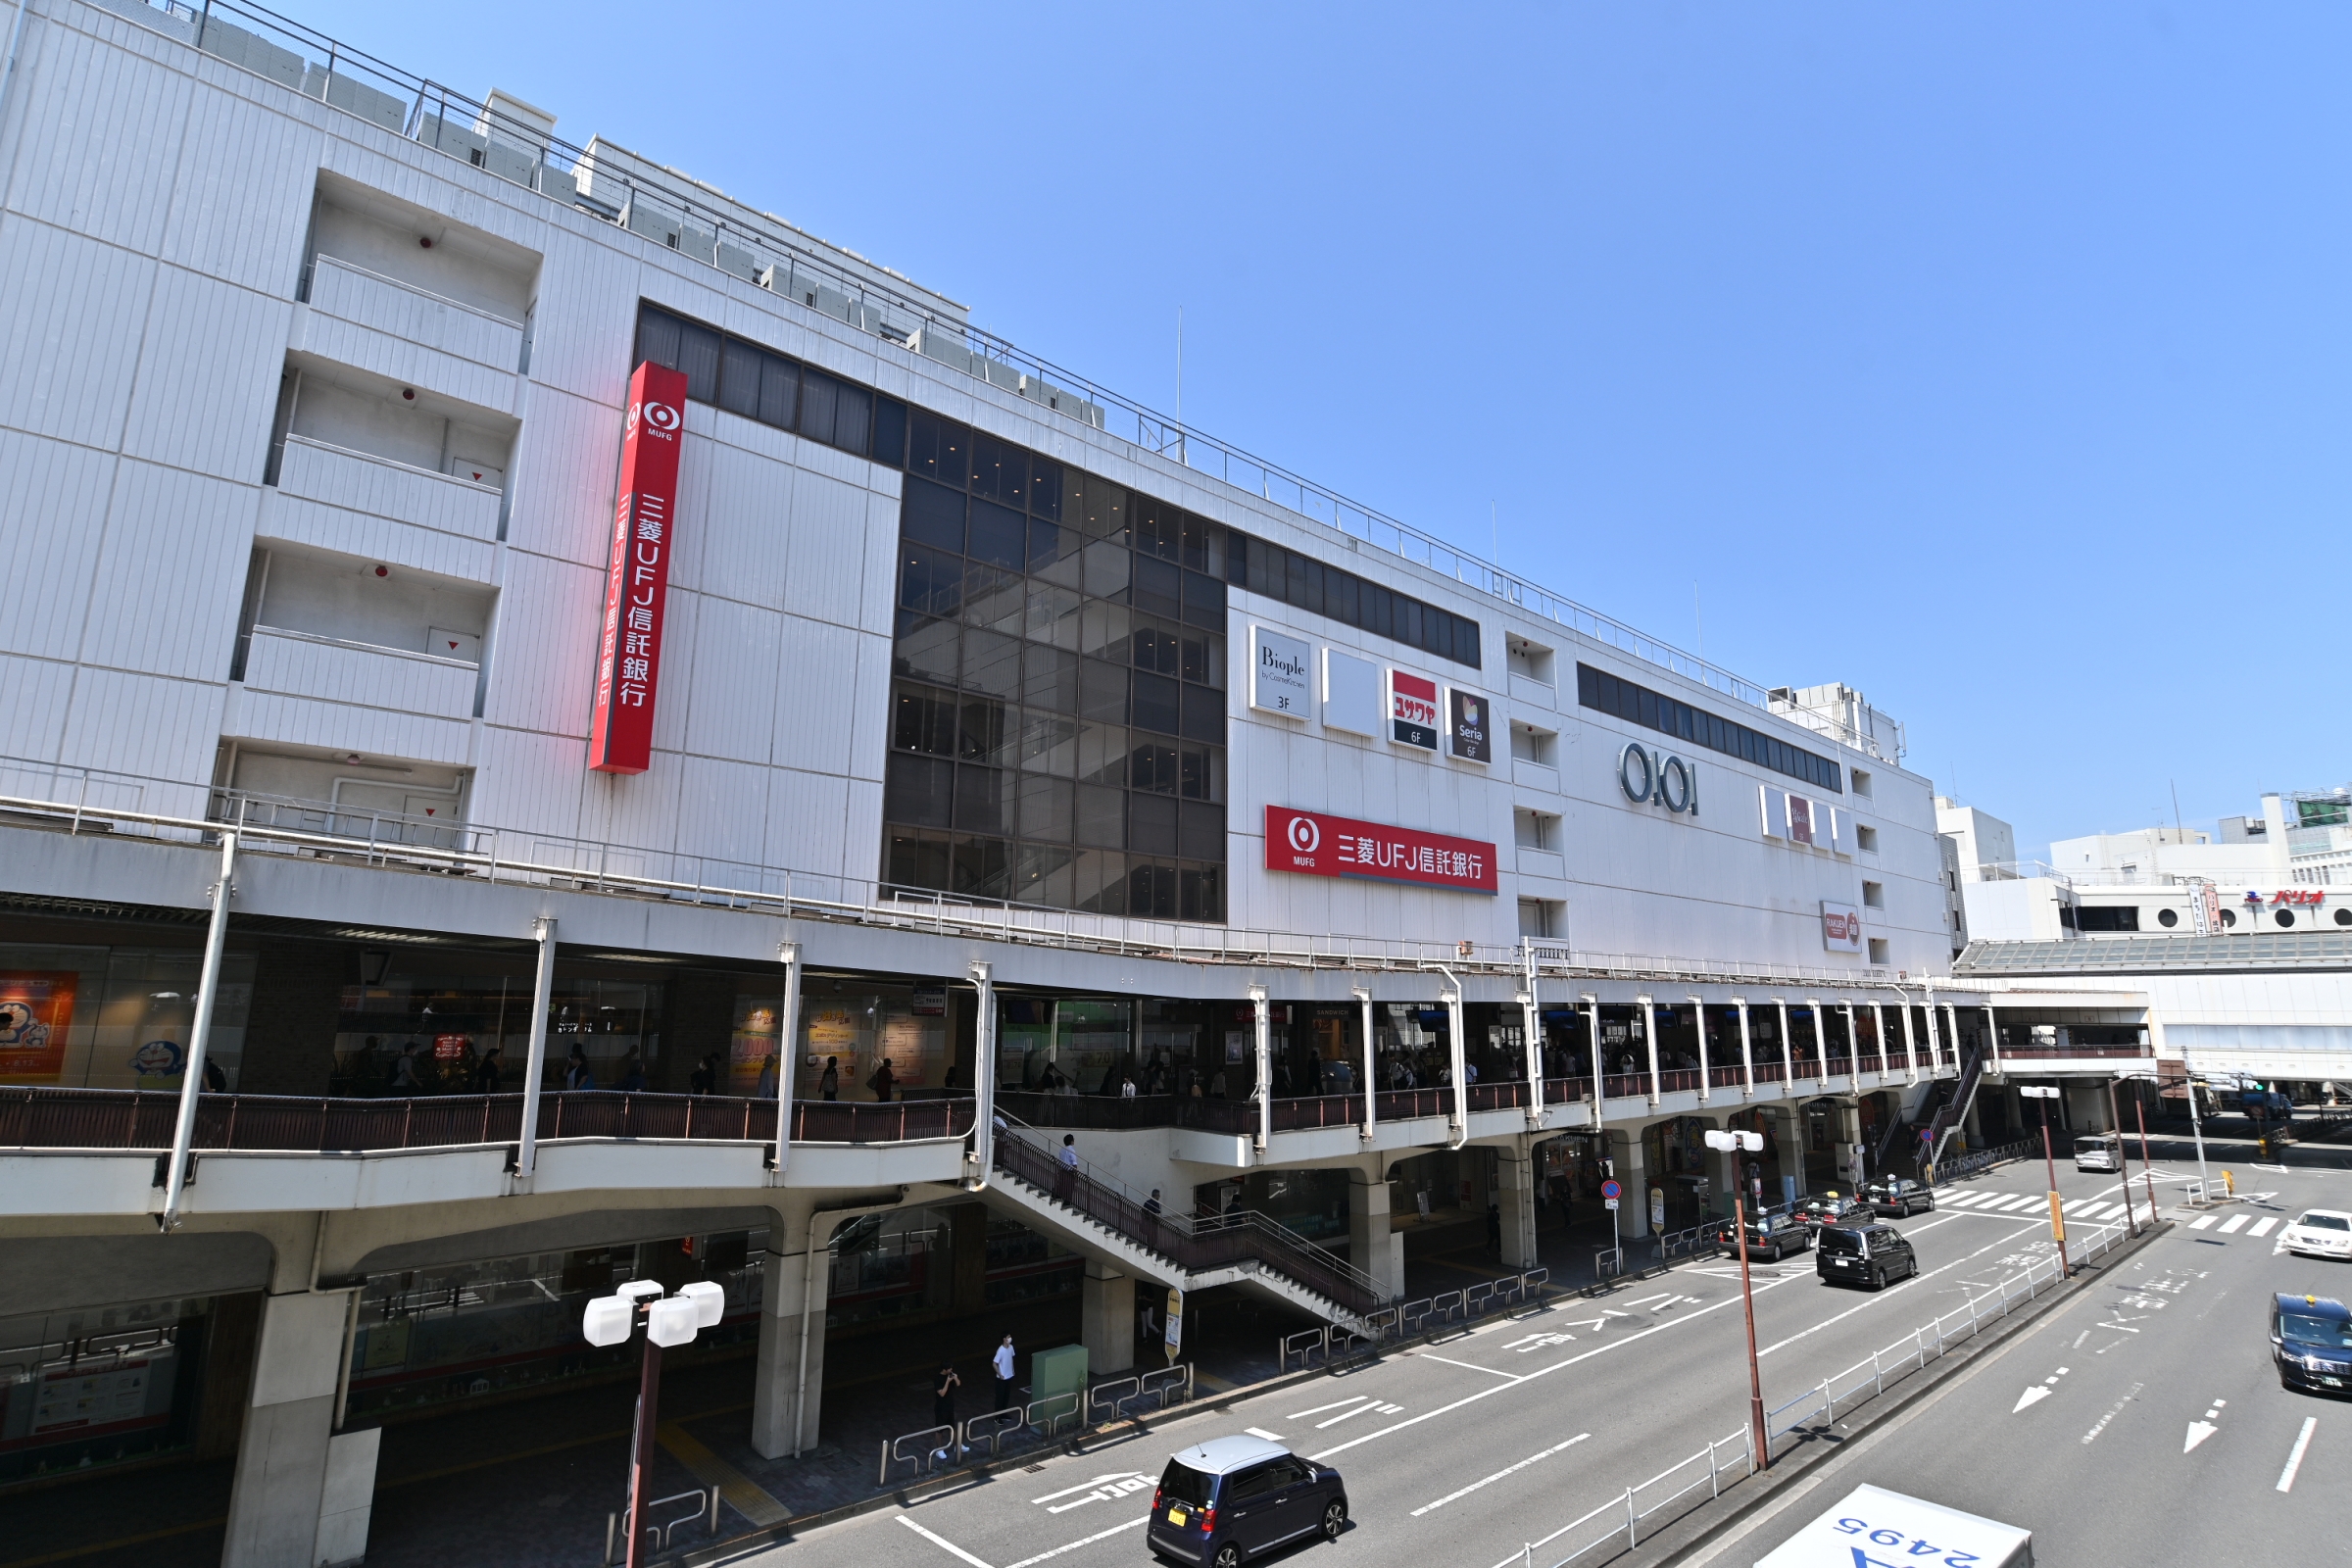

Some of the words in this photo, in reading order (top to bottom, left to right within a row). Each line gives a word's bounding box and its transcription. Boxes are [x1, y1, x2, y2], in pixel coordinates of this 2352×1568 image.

[648, 427, 672, 442] MUFG
[620, 493, 664, 708] 三菱UFJ信託銀行
[1262, 646, 1305, 676] Biople
[1278, 696, 1290, 710] 3F
[1411, 731, 1421, 744] 6F
[1459, 724, 1483, 741] Seria
[1467, 746, 1476, 758] 6F
[1293, 856, 1315, 867] MUFG
[1338, 834, 1483, 880] 三菱UFJ信託銀行
[2269, 890, 2326, 905] パリオ
